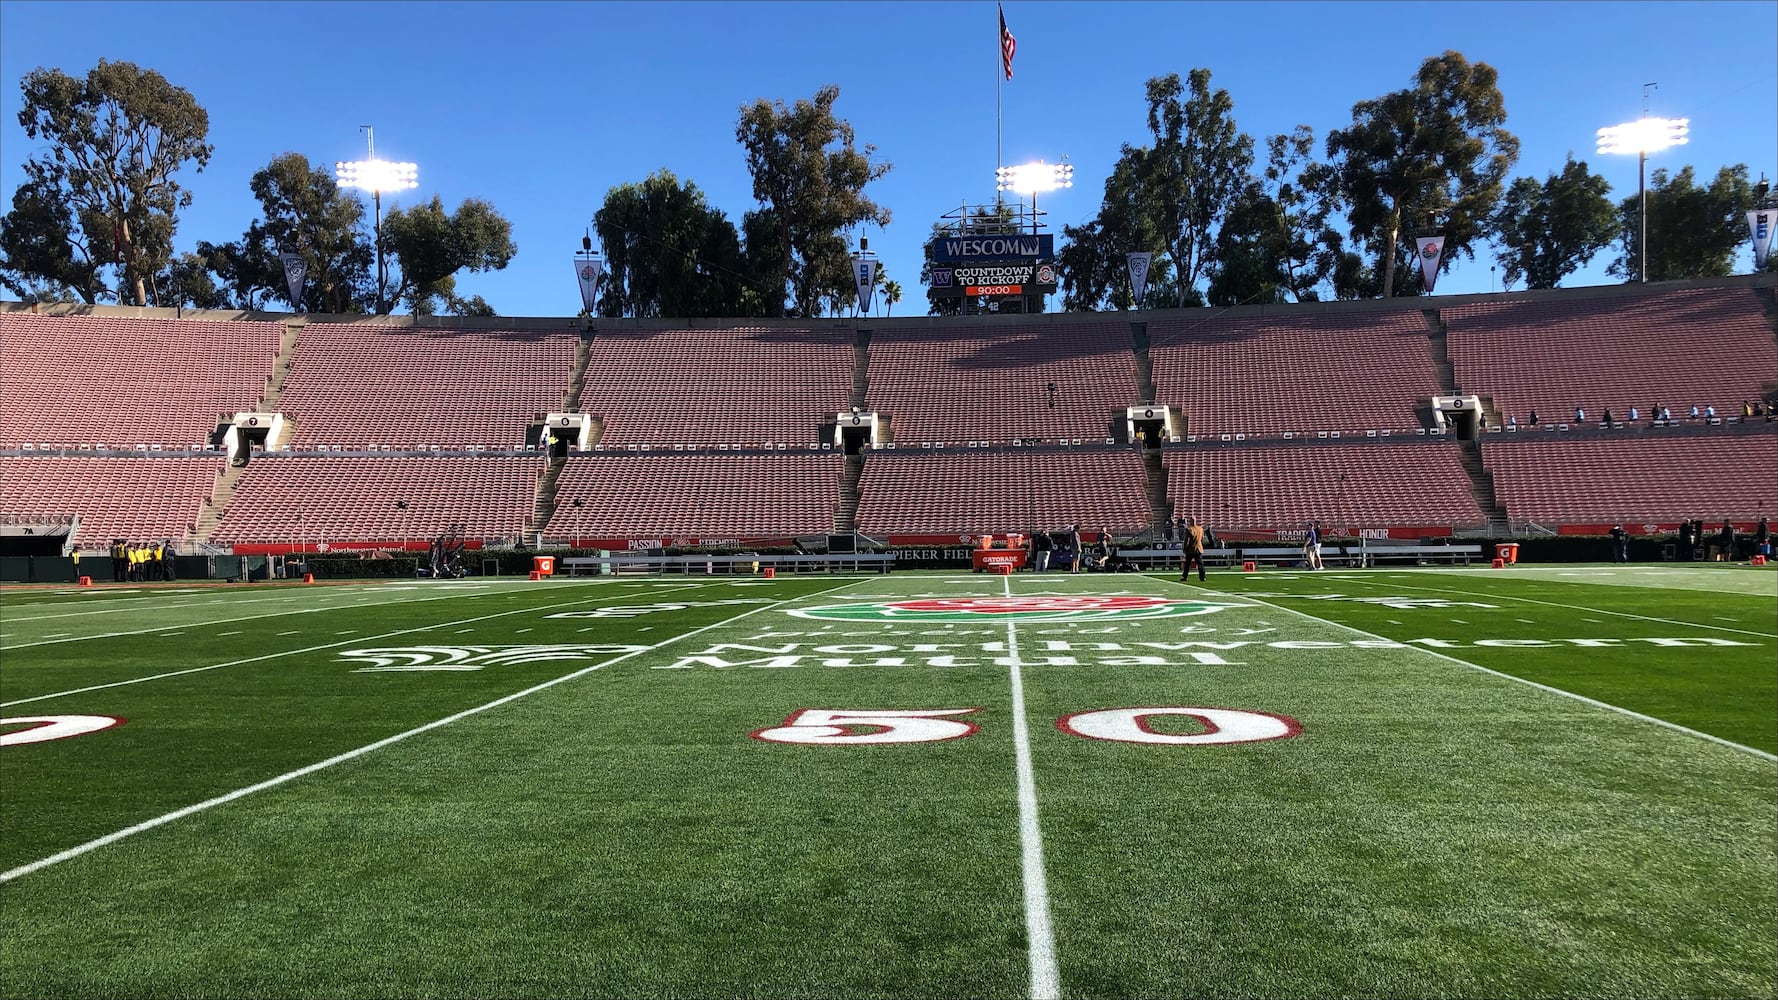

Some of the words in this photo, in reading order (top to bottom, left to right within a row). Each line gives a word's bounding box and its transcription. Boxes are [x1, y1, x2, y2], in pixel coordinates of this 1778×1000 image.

[946, 239, 1020, 256] WESCOM
[954, 266, 1034, 278] COUNTDOWN
[959, 276, 975, 286] TO
[977, 275, 1030, 285] KICKOFF
[977, 286, 1010, 295] 90:00
[987, 302, 999, 312] 42
[22, 527, 34, 535] 7A
[1359, 528, 1389, 539] HONOR
[628, 539, 662, 550] PASSION
[1500, 547, 1510, 558] G
[541, 560, 550, 571] G
[687, 637, 1767, 656] Northwestern
[650, 652, 1248, 670] Mutual
